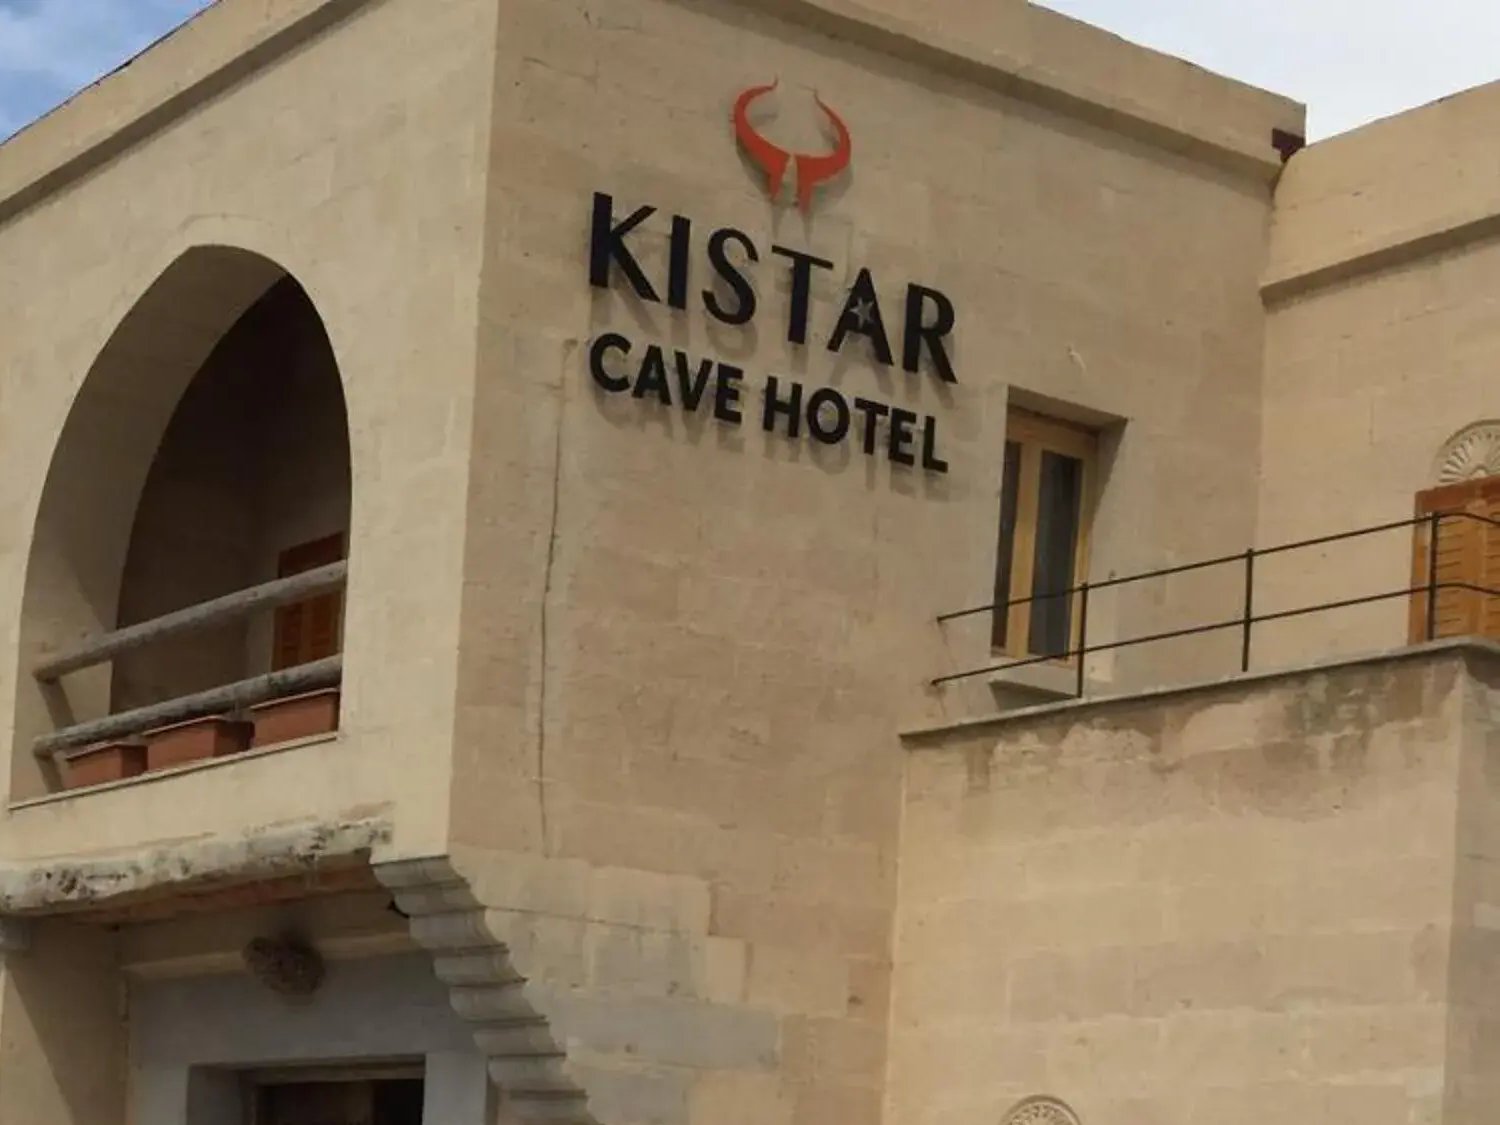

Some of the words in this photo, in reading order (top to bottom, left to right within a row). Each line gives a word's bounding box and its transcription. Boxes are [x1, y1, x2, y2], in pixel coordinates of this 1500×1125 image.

[589, 192, 958, 384] KISTAR
[589, 333, 744, 424] CAVE
[762, 375, 949, 473] HOTEL
